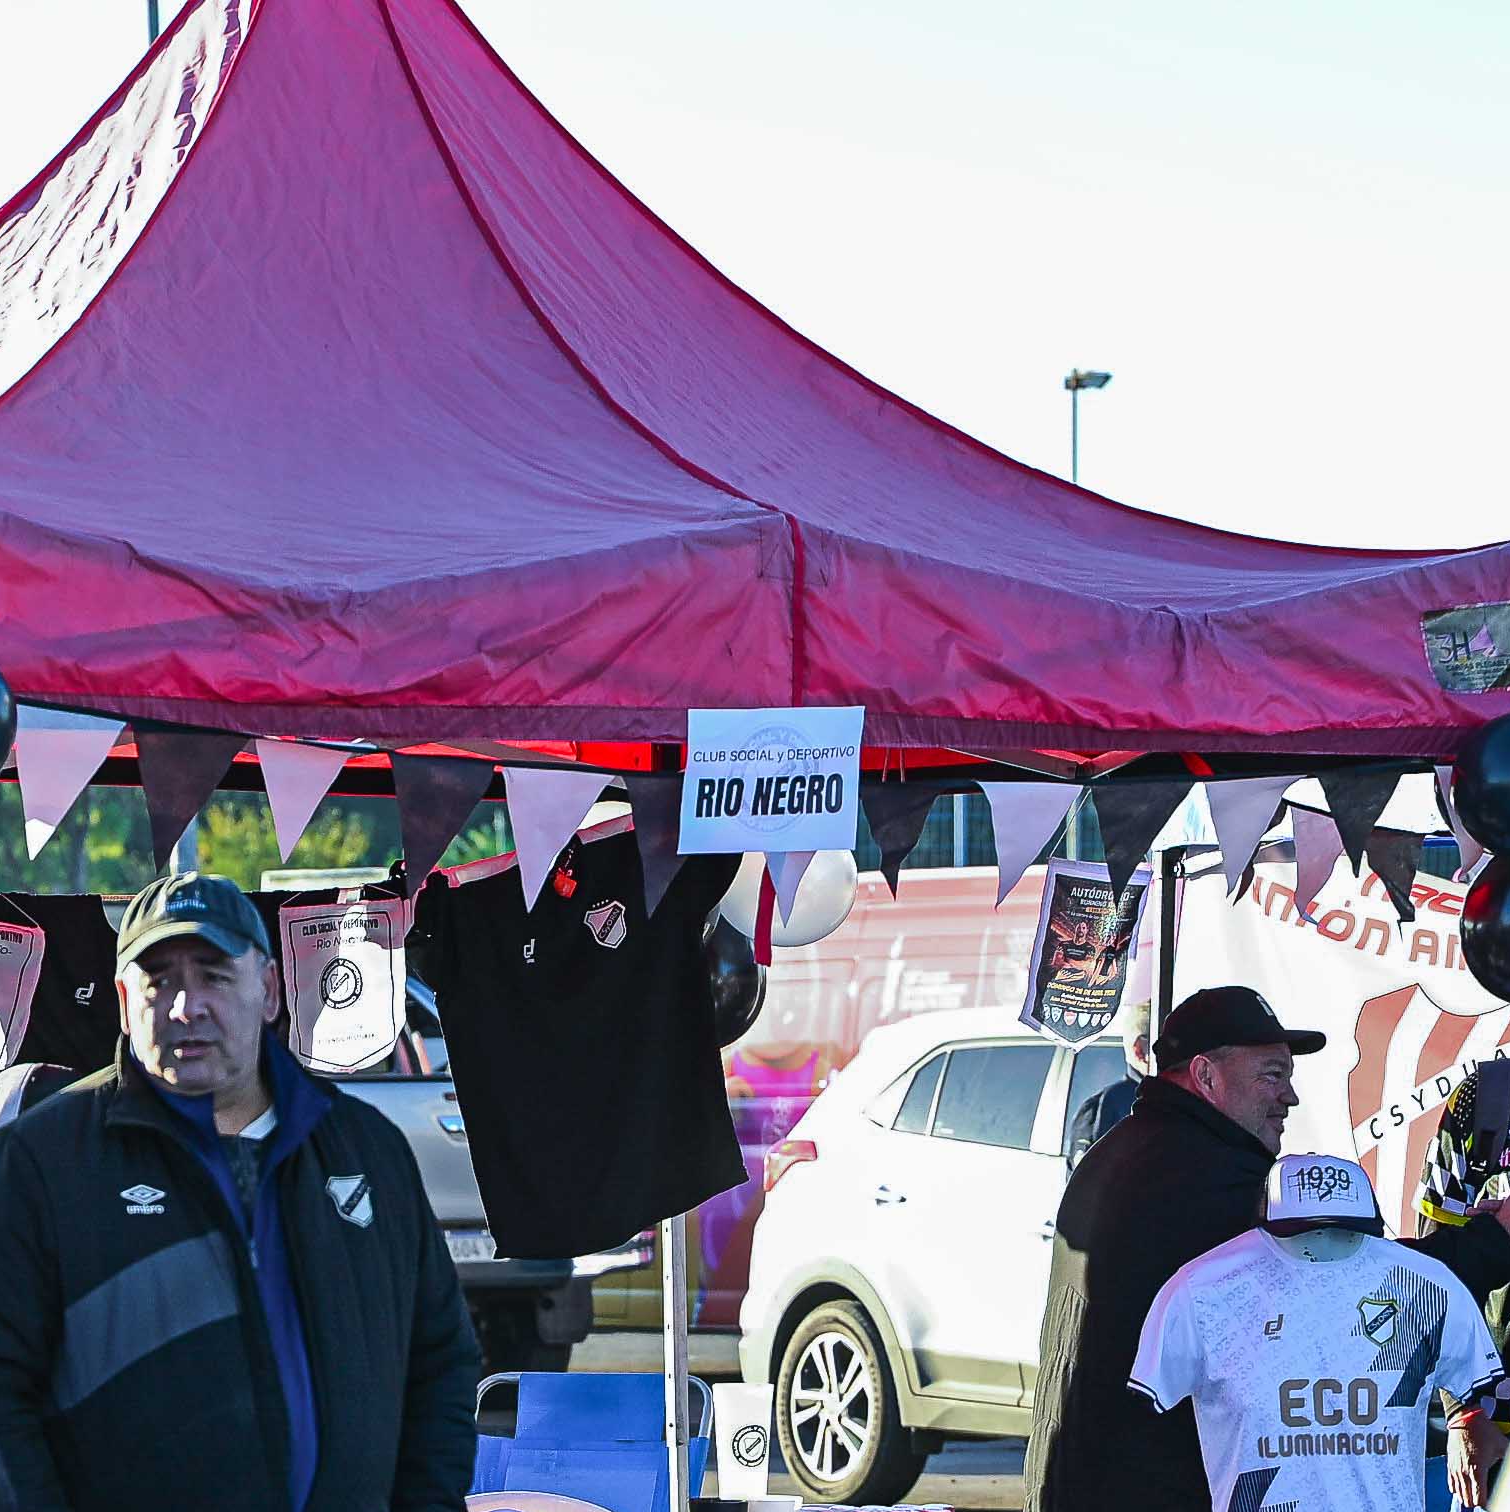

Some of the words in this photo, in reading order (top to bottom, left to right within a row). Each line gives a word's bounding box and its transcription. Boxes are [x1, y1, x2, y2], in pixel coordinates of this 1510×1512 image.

[694, 751, 726, 762] CLUB
[730, 750, 774, 761] SOCIAL
[788, 746, 855, 760] DEPORTIVO
[696, 778, 744, 817] RIO
[751, 773, 843, 816] NEGRO
[1253, 876, 1390, 956] NIÓN
[1295, 1165, 1350, 1190] 1939
[1279, 1378, 1378, 1427] ECO
[1257, 1426, 1400, 1458] ILUMINACIÓN
